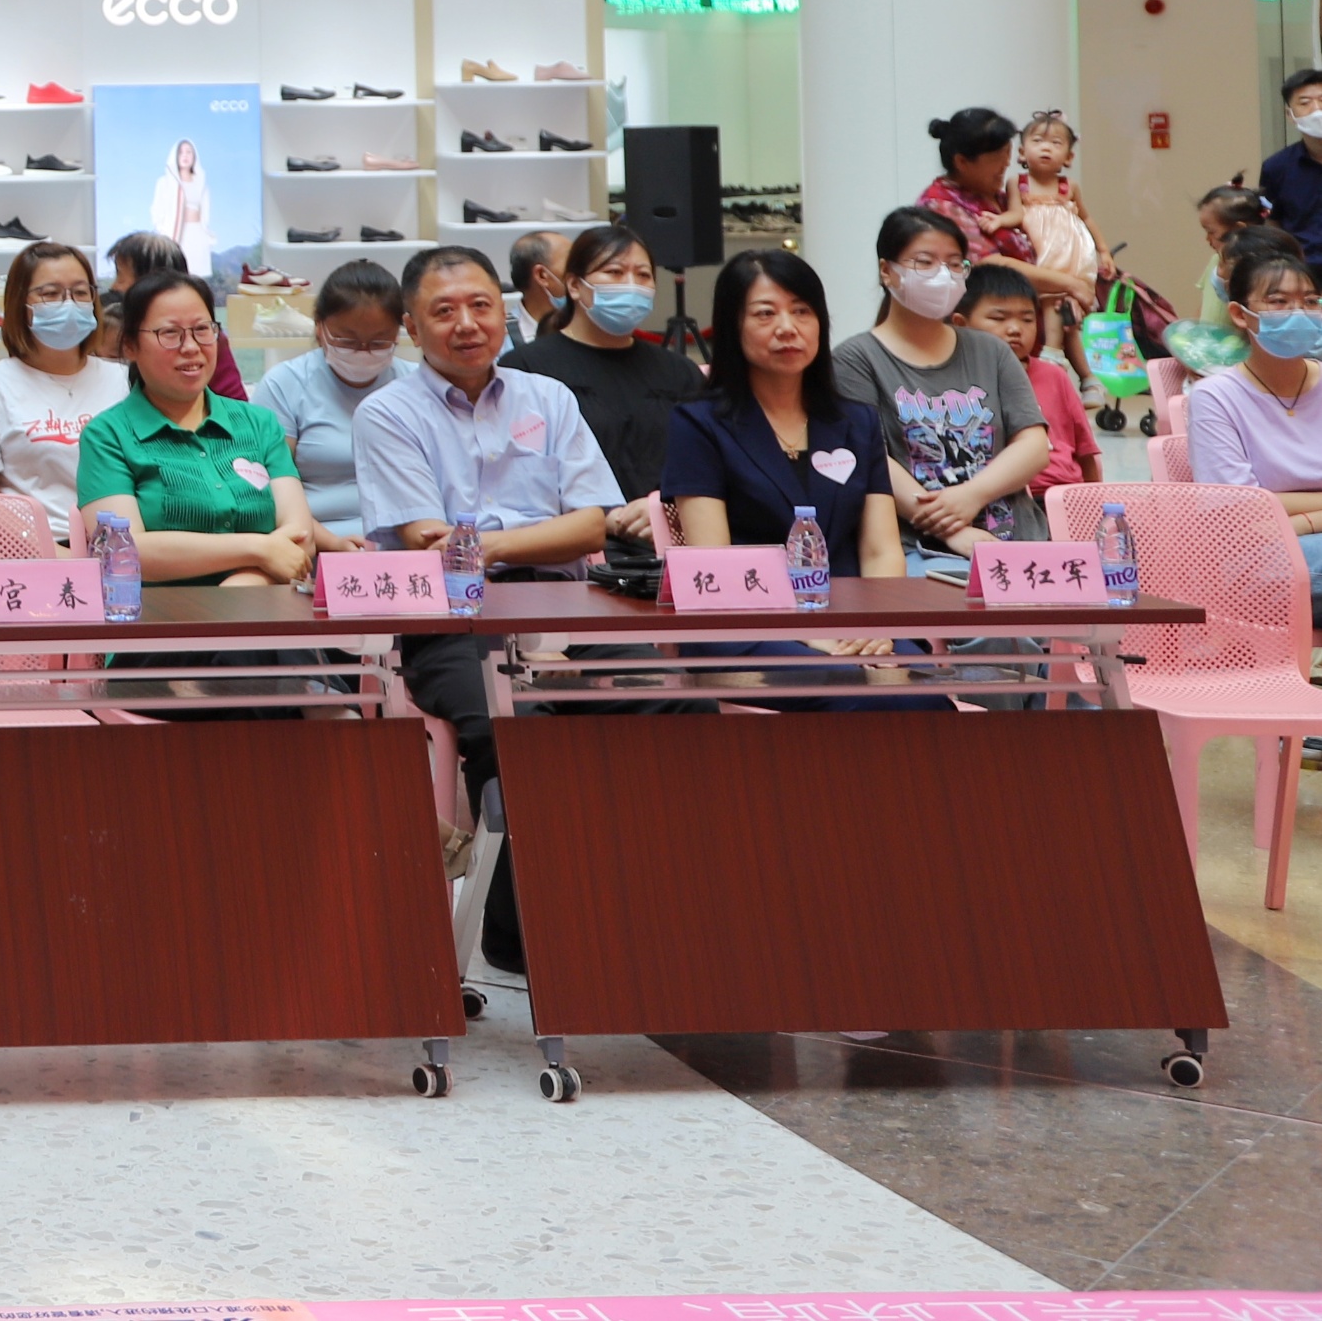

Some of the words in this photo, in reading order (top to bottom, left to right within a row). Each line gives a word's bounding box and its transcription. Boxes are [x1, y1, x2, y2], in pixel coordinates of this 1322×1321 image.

[209, 99, 249, 112] ecco
[988, 558, 1089, 592] 李红军
